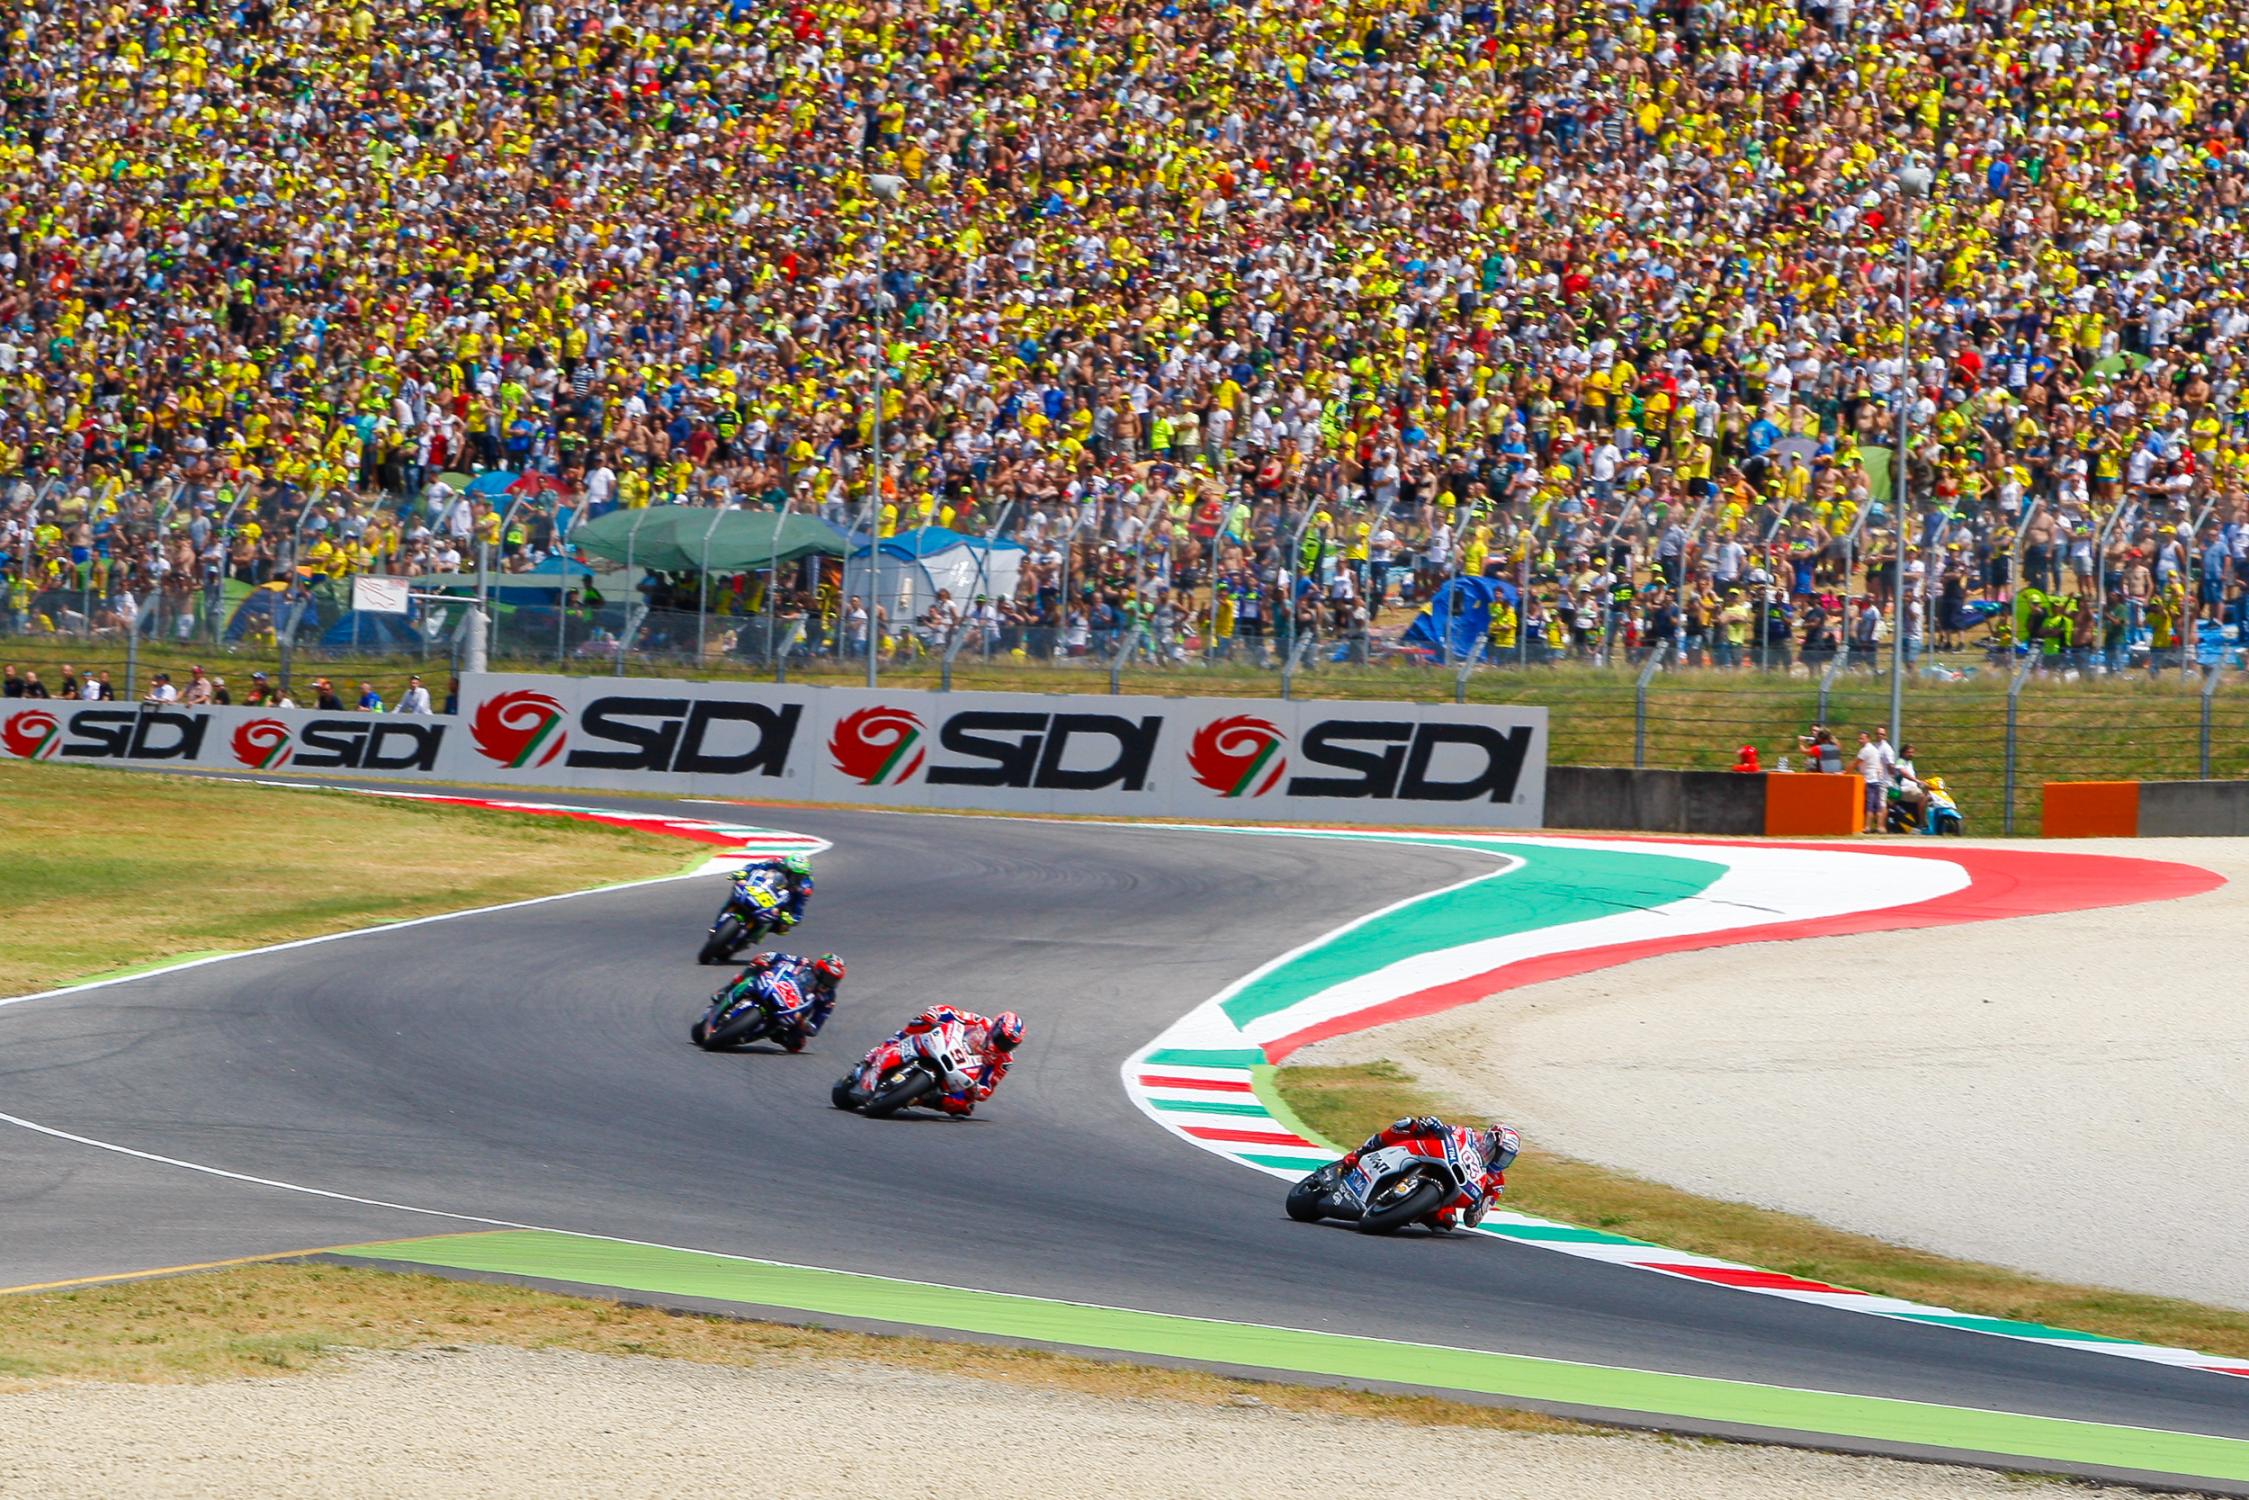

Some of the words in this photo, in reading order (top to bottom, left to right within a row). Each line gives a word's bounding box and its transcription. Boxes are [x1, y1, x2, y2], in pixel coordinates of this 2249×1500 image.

[61, 709, 210, 760] SIDI
[292, 720, 447, 772] SIDI
[565, 696, 804, 778] SIDI
[926, 711, 1164, 792] SIDI
[1287, 720, 1533, 804] SIDI
